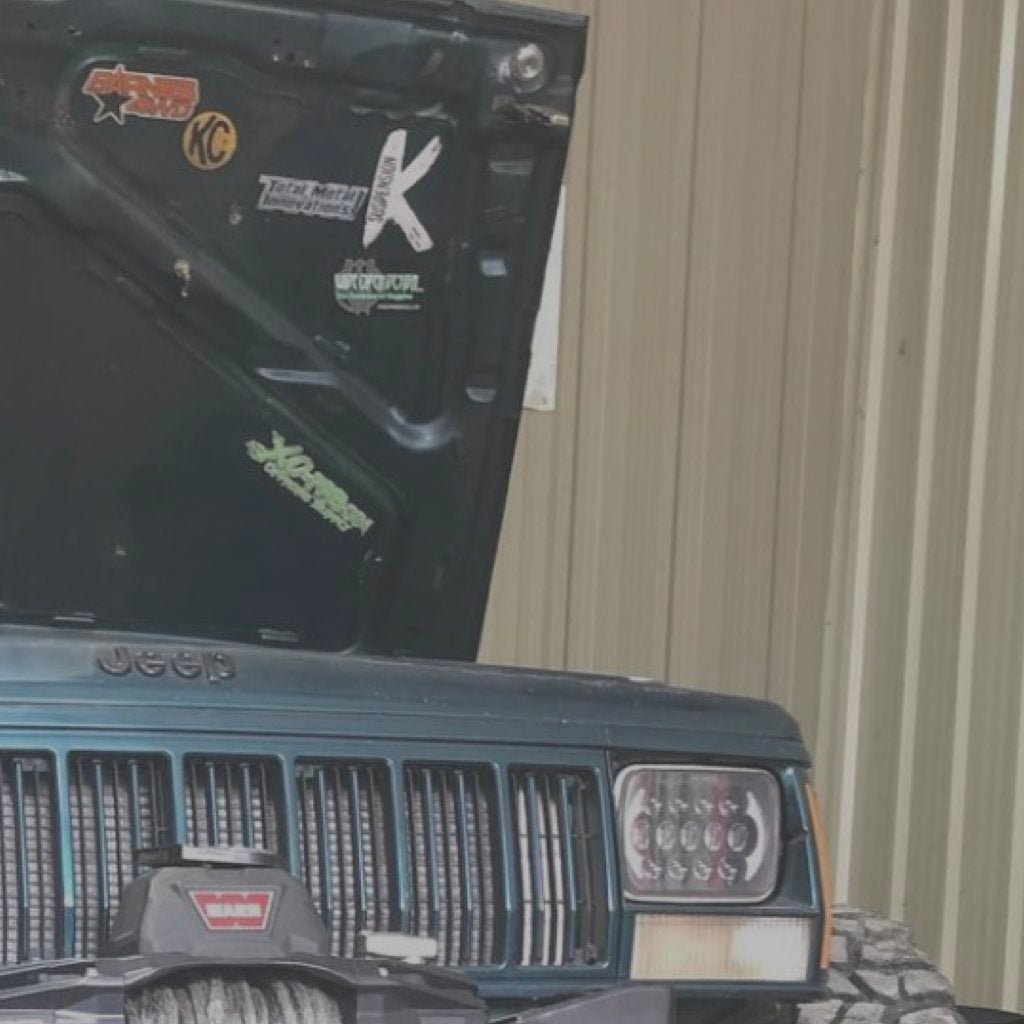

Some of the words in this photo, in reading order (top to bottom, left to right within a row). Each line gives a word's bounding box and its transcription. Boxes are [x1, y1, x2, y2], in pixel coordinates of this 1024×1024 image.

[190, 114, 231, 165] KC
[267, 179, 308, 197] Total
[97, 646, 237, 684] Jeep
